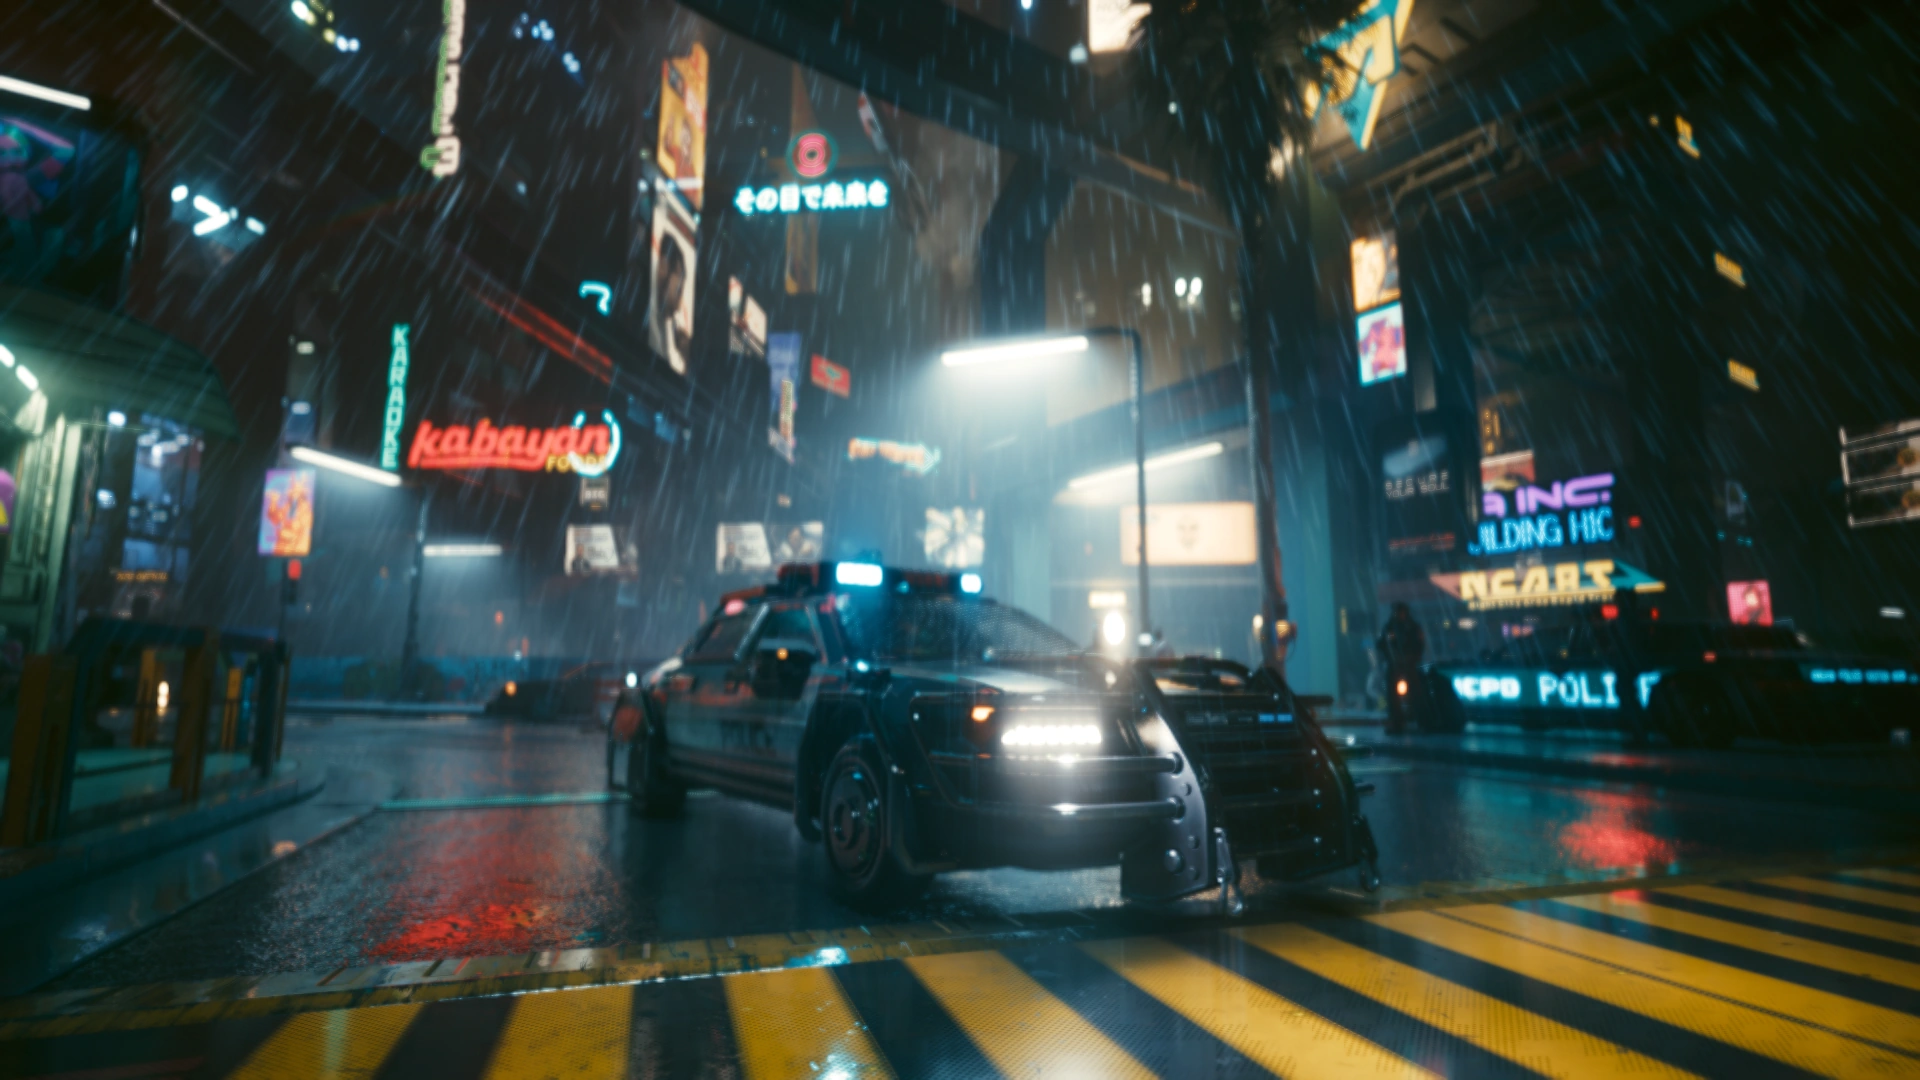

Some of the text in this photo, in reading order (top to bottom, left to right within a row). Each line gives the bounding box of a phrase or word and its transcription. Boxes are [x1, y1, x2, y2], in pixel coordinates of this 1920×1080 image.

[381, 323, 410, 470] KARAOKE
[407, 418, 611, 471] kabayan
[545, 454, 606, 473] FOD
[1385, 471, 1449, 490] SECURE
[1386, 482, 1450, 499] YOUR SOUL
